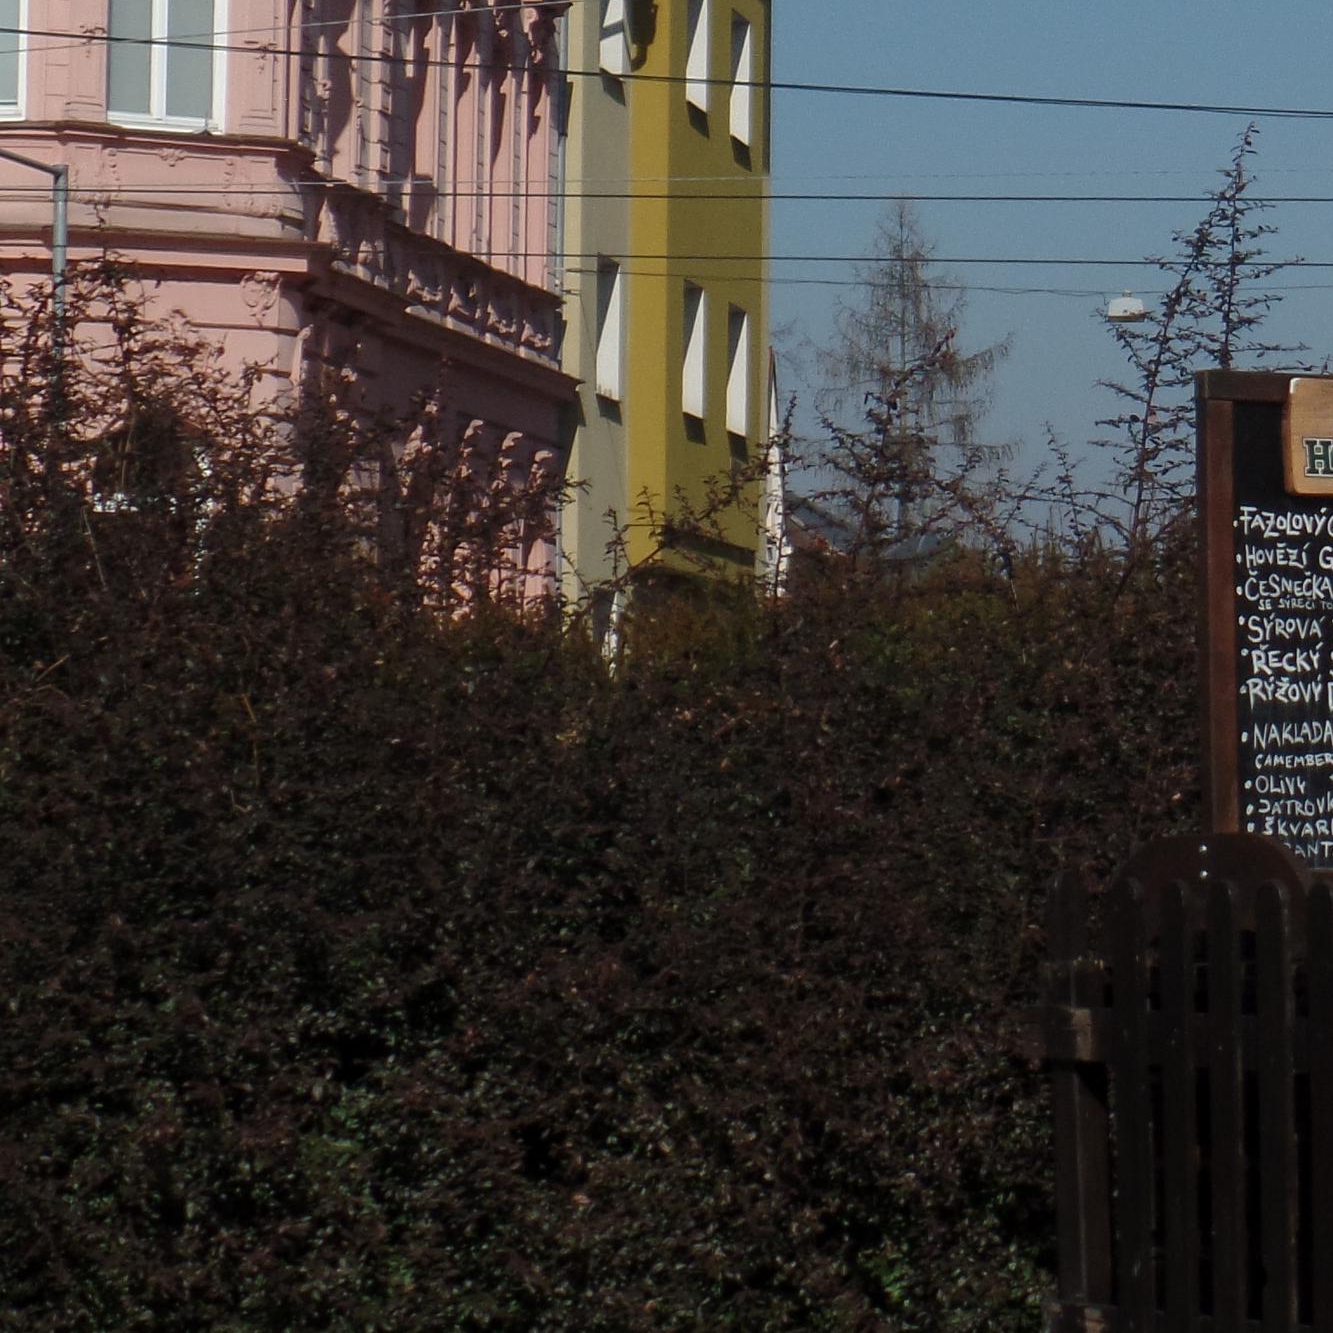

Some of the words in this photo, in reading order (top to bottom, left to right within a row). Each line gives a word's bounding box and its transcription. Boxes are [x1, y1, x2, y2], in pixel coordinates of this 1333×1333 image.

[1239, 506, 1327, 539] FAZOLOVÝ
[1245, 542, 1311, 568] HOVĚZÍ
[1258, 599, 1271, 611] SE
[1247, 613, 1326, 643] SÝROVÁ
[1252, 642, 1324, 675] ŘECKÝ
[1246, 674, 1322, 711] RÝŽOVÝ
